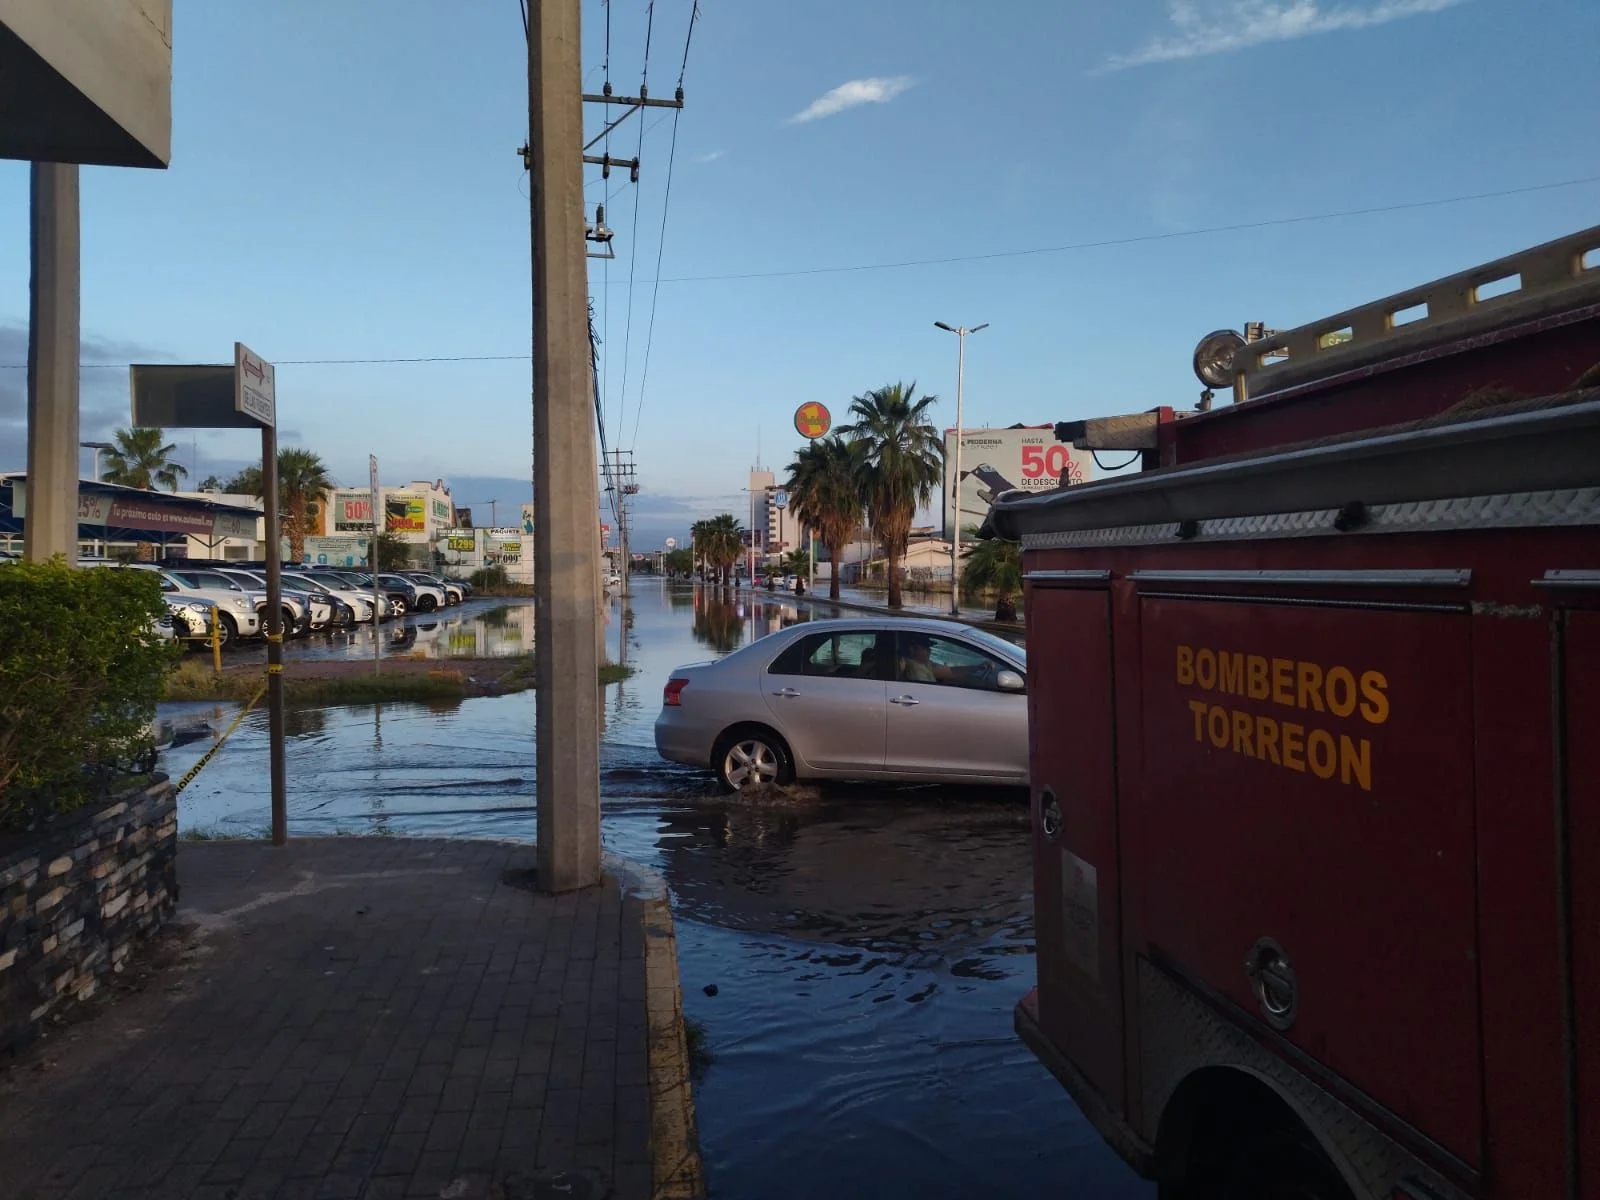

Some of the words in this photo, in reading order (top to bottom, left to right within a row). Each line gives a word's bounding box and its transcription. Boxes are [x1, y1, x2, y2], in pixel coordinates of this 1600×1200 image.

[1021, 444, 1082, 478] 50%
[1021, 478, 1032, 486] DE
[1033, 478, 1083, 486] DESCUTO
[113, 503, 120, 517] Tu
[1176, 645, 1390, 724] BOMBEROS
[1188, 699, 1372, 792] TORREON
